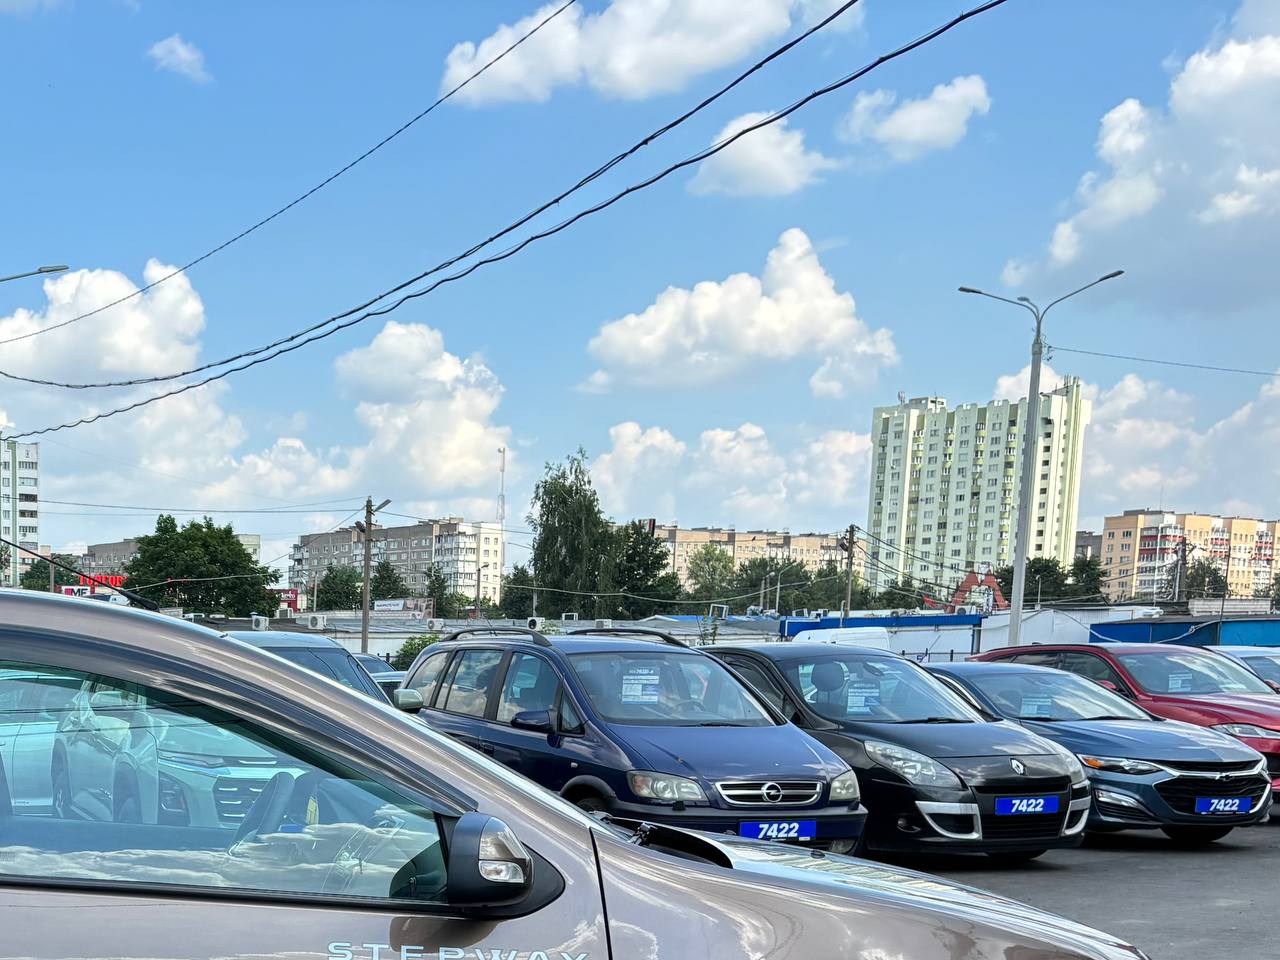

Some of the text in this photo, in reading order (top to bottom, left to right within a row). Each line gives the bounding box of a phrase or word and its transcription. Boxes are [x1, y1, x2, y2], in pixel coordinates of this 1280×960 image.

[1011, 798, 1044, 813] 7422
[1210, 798, 1239, 811] 7422
[757, 822, 799, 839] 7422
